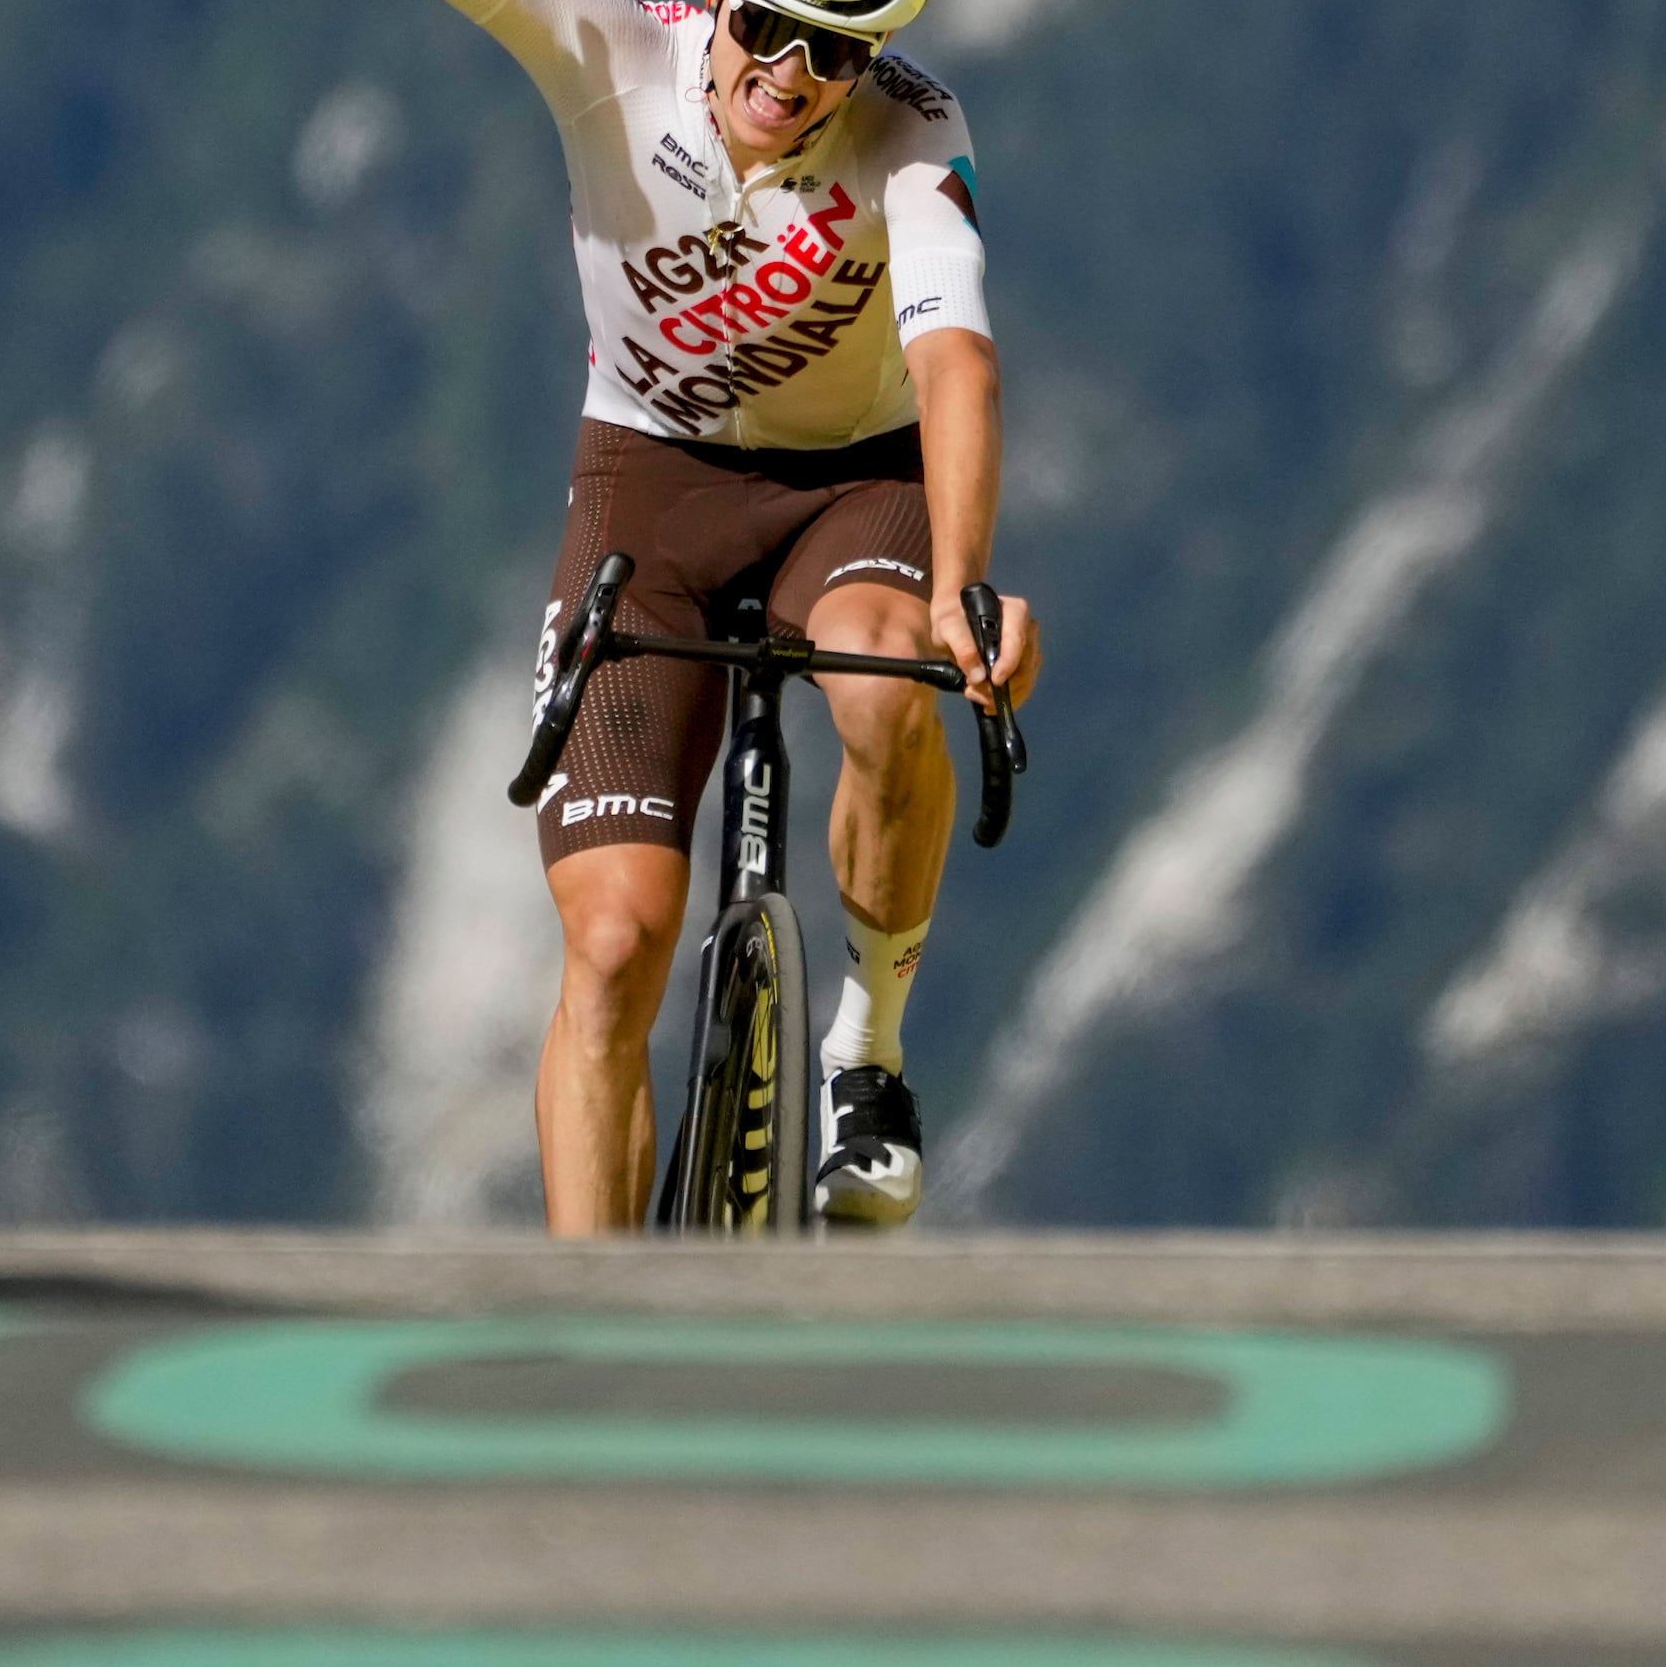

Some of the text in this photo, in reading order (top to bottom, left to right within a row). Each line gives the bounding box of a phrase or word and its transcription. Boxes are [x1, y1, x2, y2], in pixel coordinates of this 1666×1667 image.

[621, 220, 770, 314] AG2R
[659, 182, 856, 355] CITROËN
[896, 297, 942, 331] MC
[614, 336, 679, 396] LA
[650, 259, 886, 436] MONDIALE
[561, 794, 675, 827] BMC
[738, 758, 771, 875] BMC
